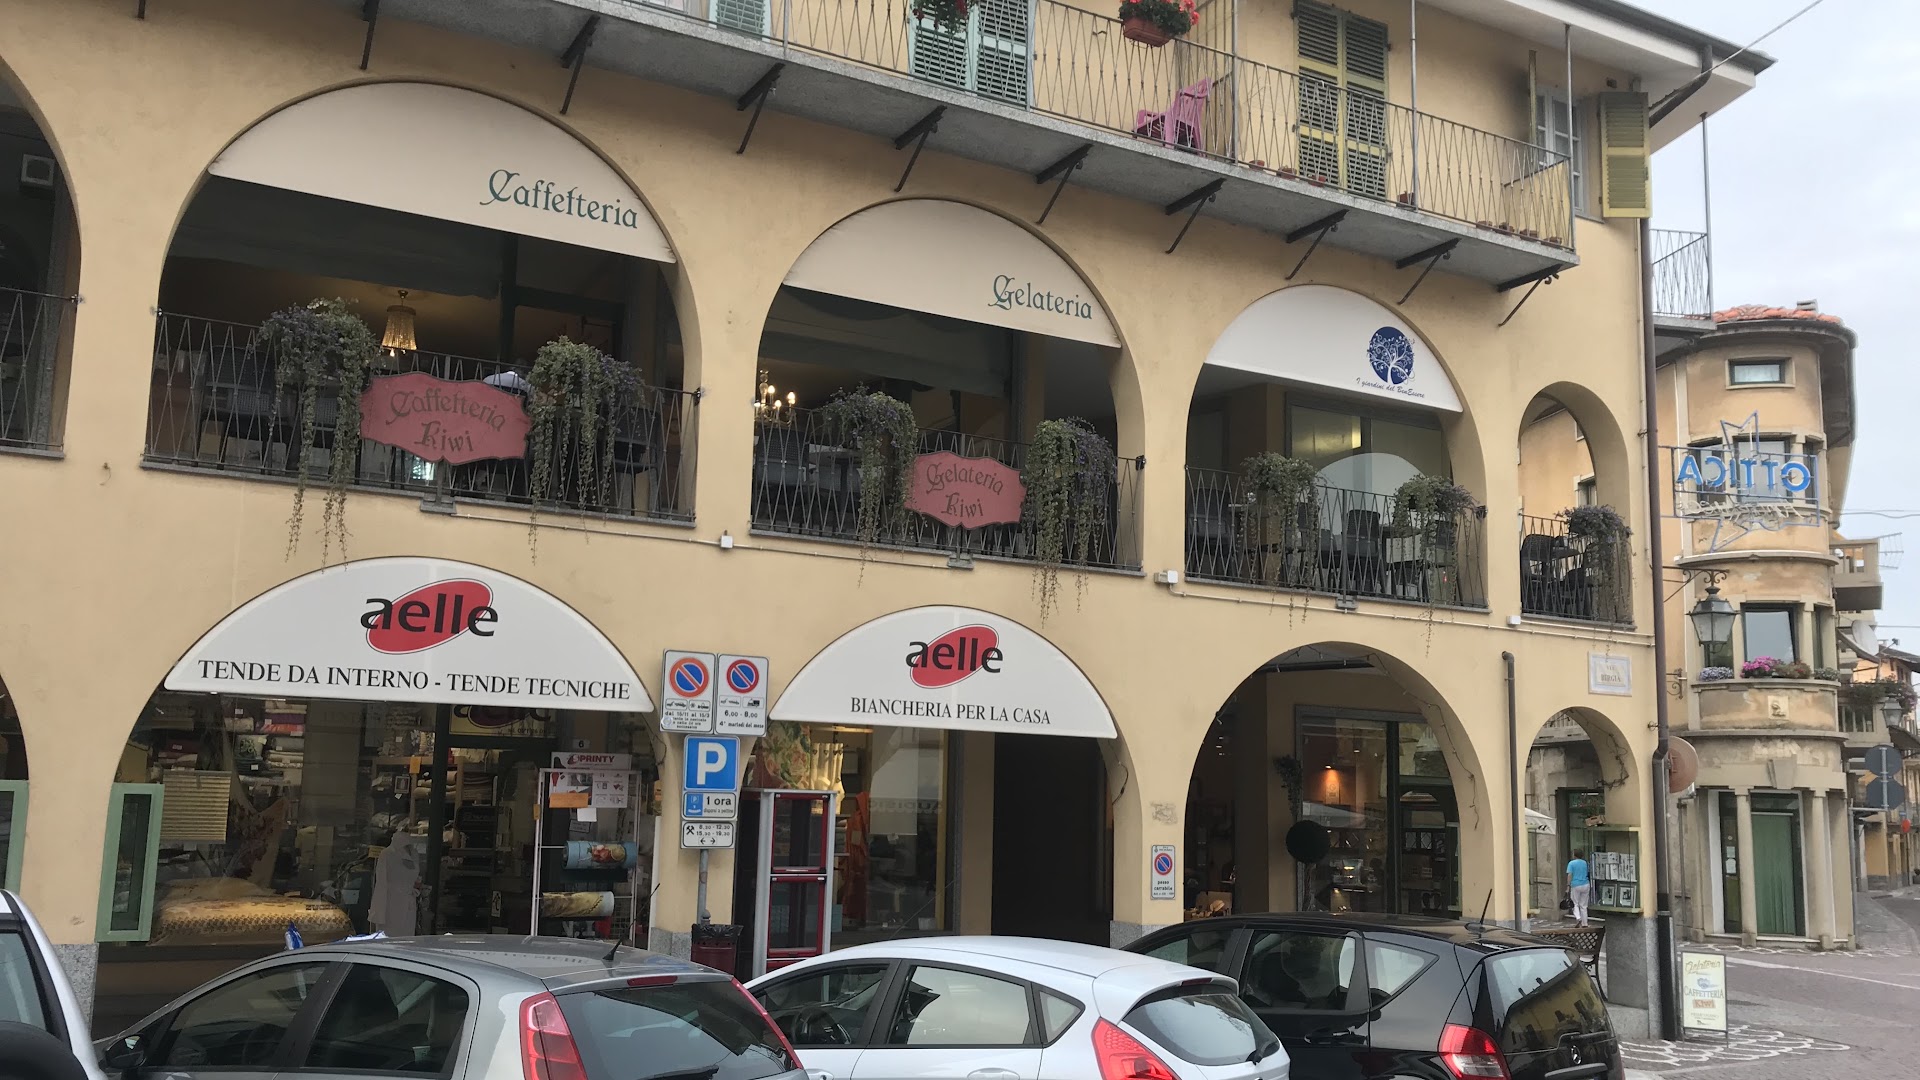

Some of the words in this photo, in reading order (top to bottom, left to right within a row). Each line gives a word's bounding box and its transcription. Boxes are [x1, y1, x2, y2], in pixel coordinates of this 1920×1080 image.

[479, 169, 638, 229] Caffetteria
[987, 274, 1093, 320] Gelateria
[1361, 380, 1385, 390] giardini
[1386, 384, 1396, 392] del
[385, 387, 506, 433] Caffetteria
[413, 420, 475, 452] Kiwi
[925, 462, 1004, 496] Gelateria
[940, 492, 984, 519] Kiwi
[360, 593, 499, 638] aelle
[905, 636, 1004, 674] aelle
[198, 659, 281, 683] TENDE
[287, 664, 321, 685] DA
[326, 666, 430, 691] INTERNO
[446, 673, 521, 695] TENDE
[525, 677, 631, 701] TECNICHE
[850, 697, 952, 719] BIANCHERIA
[956, 704, 987, 721] PER
[990, 706, 1009, 722] LA
[1013, 707, 1051, 725] CASA
[578, 740, 585, 748] 6
[696, 741, 728, 785] P
[706, 796, 710, 805] 1
[714, 798, 732, 806] ora
[1684, 986, 1725, 999] CAFFETTERIA
